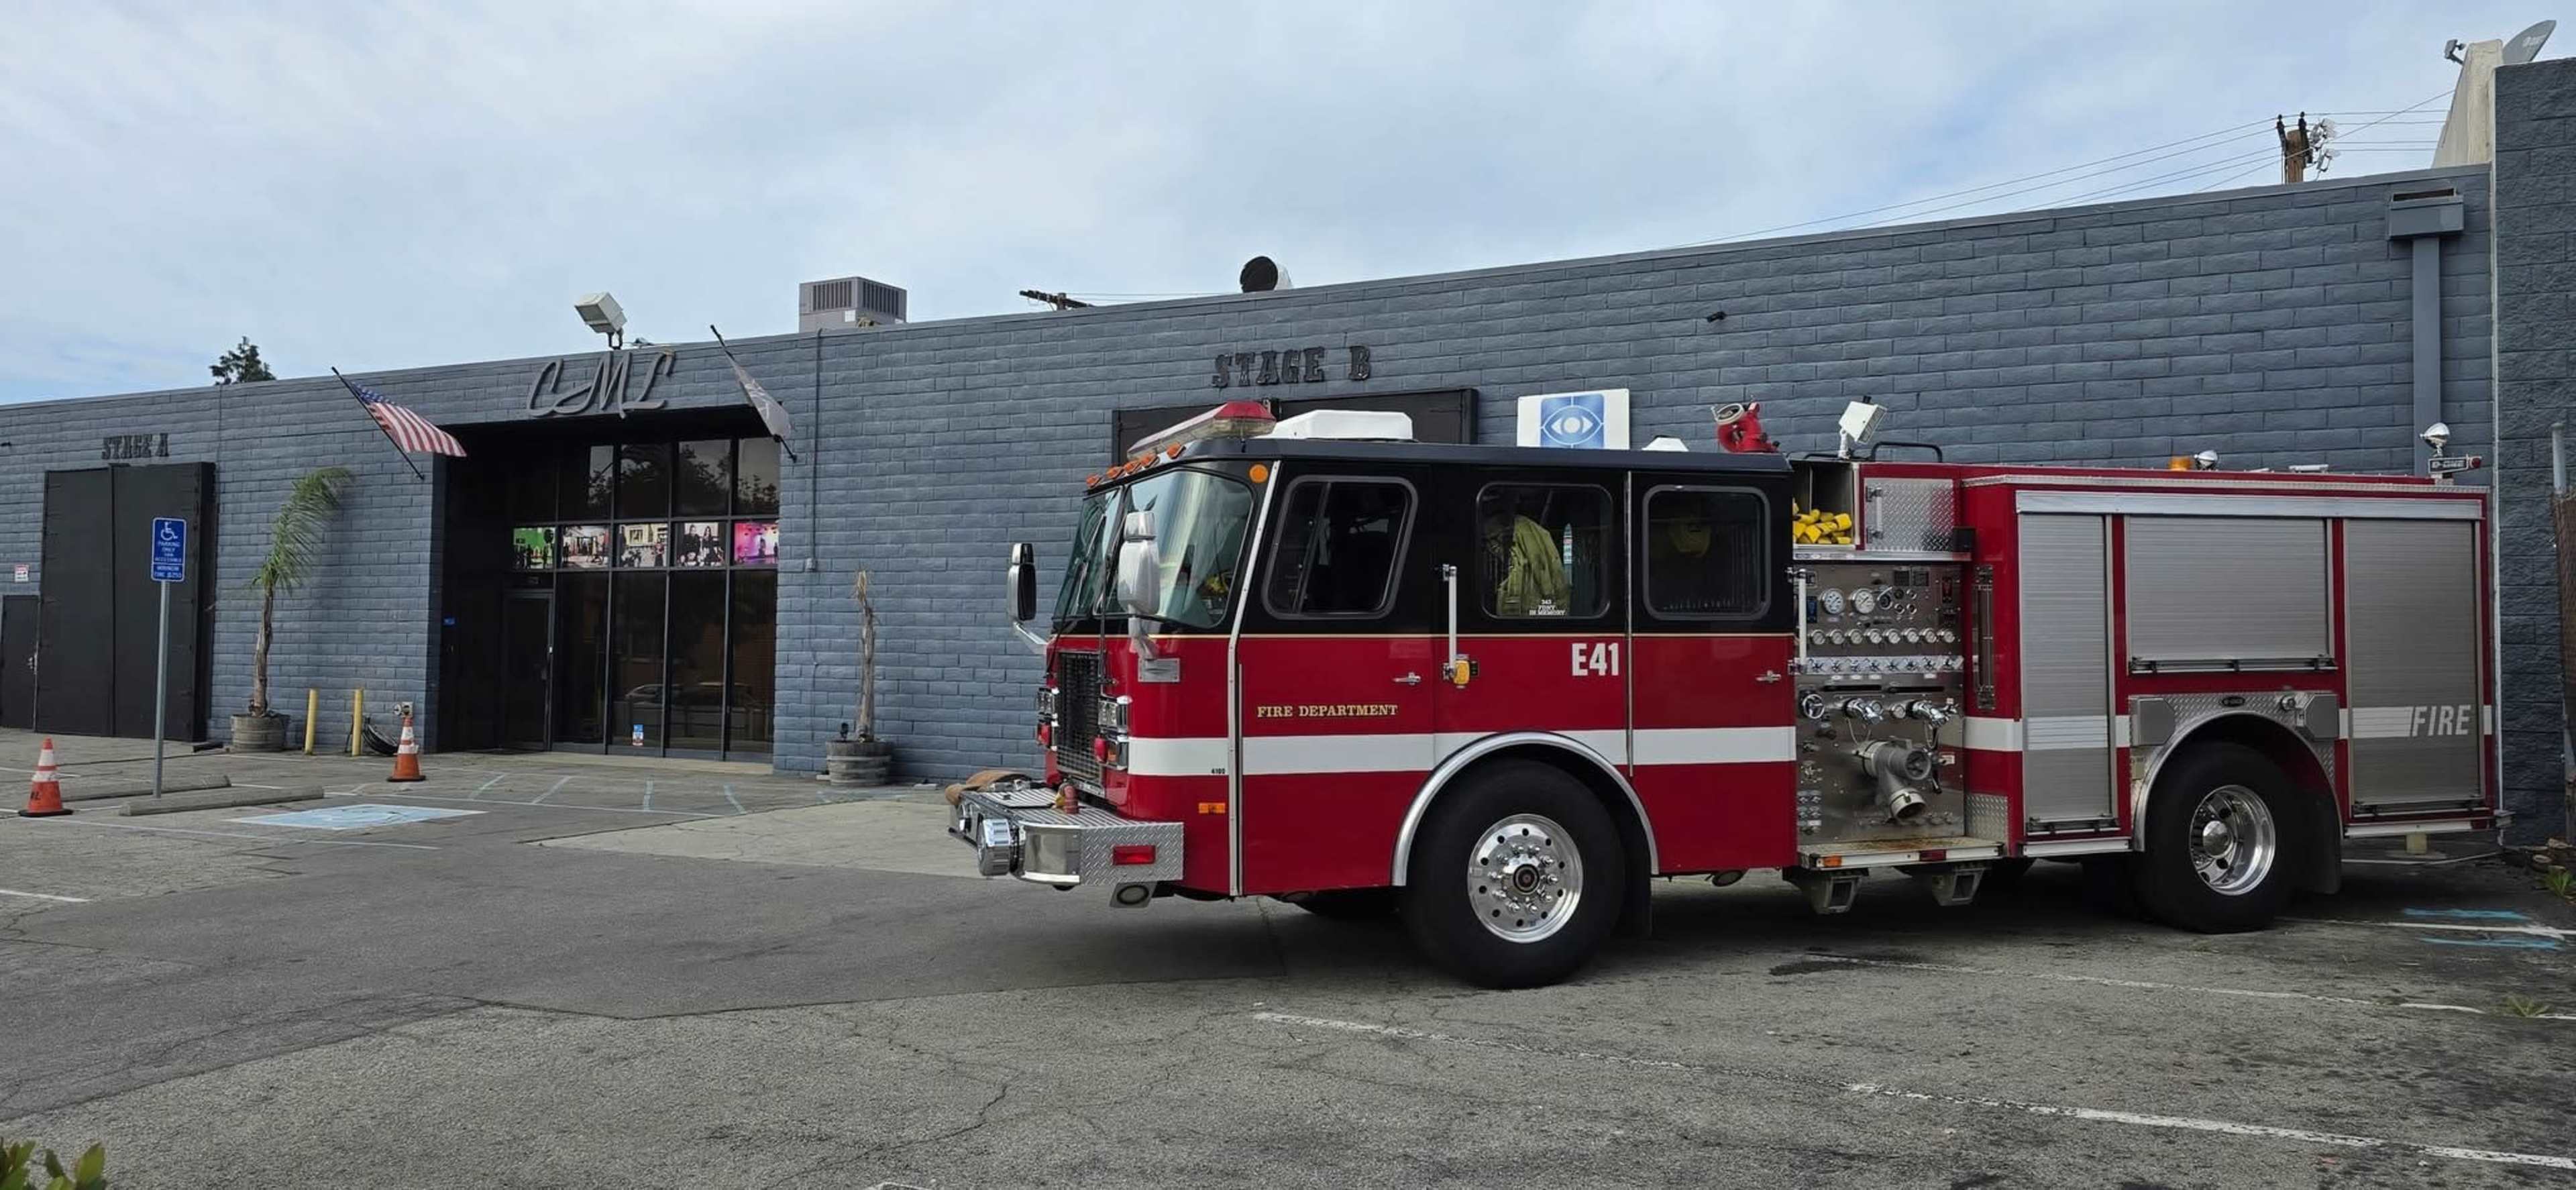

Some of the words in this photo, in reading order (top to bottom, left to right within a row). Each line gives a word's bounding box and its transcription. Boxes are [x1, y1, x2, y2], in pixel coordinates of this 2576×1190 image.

[1212, 346, 1325, 388] STAGE
[1348, 345, 1371, 381] B
[526, 351, 676, 420] CML
[102, 436, 152, 459] STAGE
[155, 433, 170, 457] A
[1572, 643, 1619, 676] E41
[1257, 706, 1293, 718] FIRE
[1299, 704, 1397, 716] DEPARTMENT
[2412, 705, 2471, 737] FIRE
